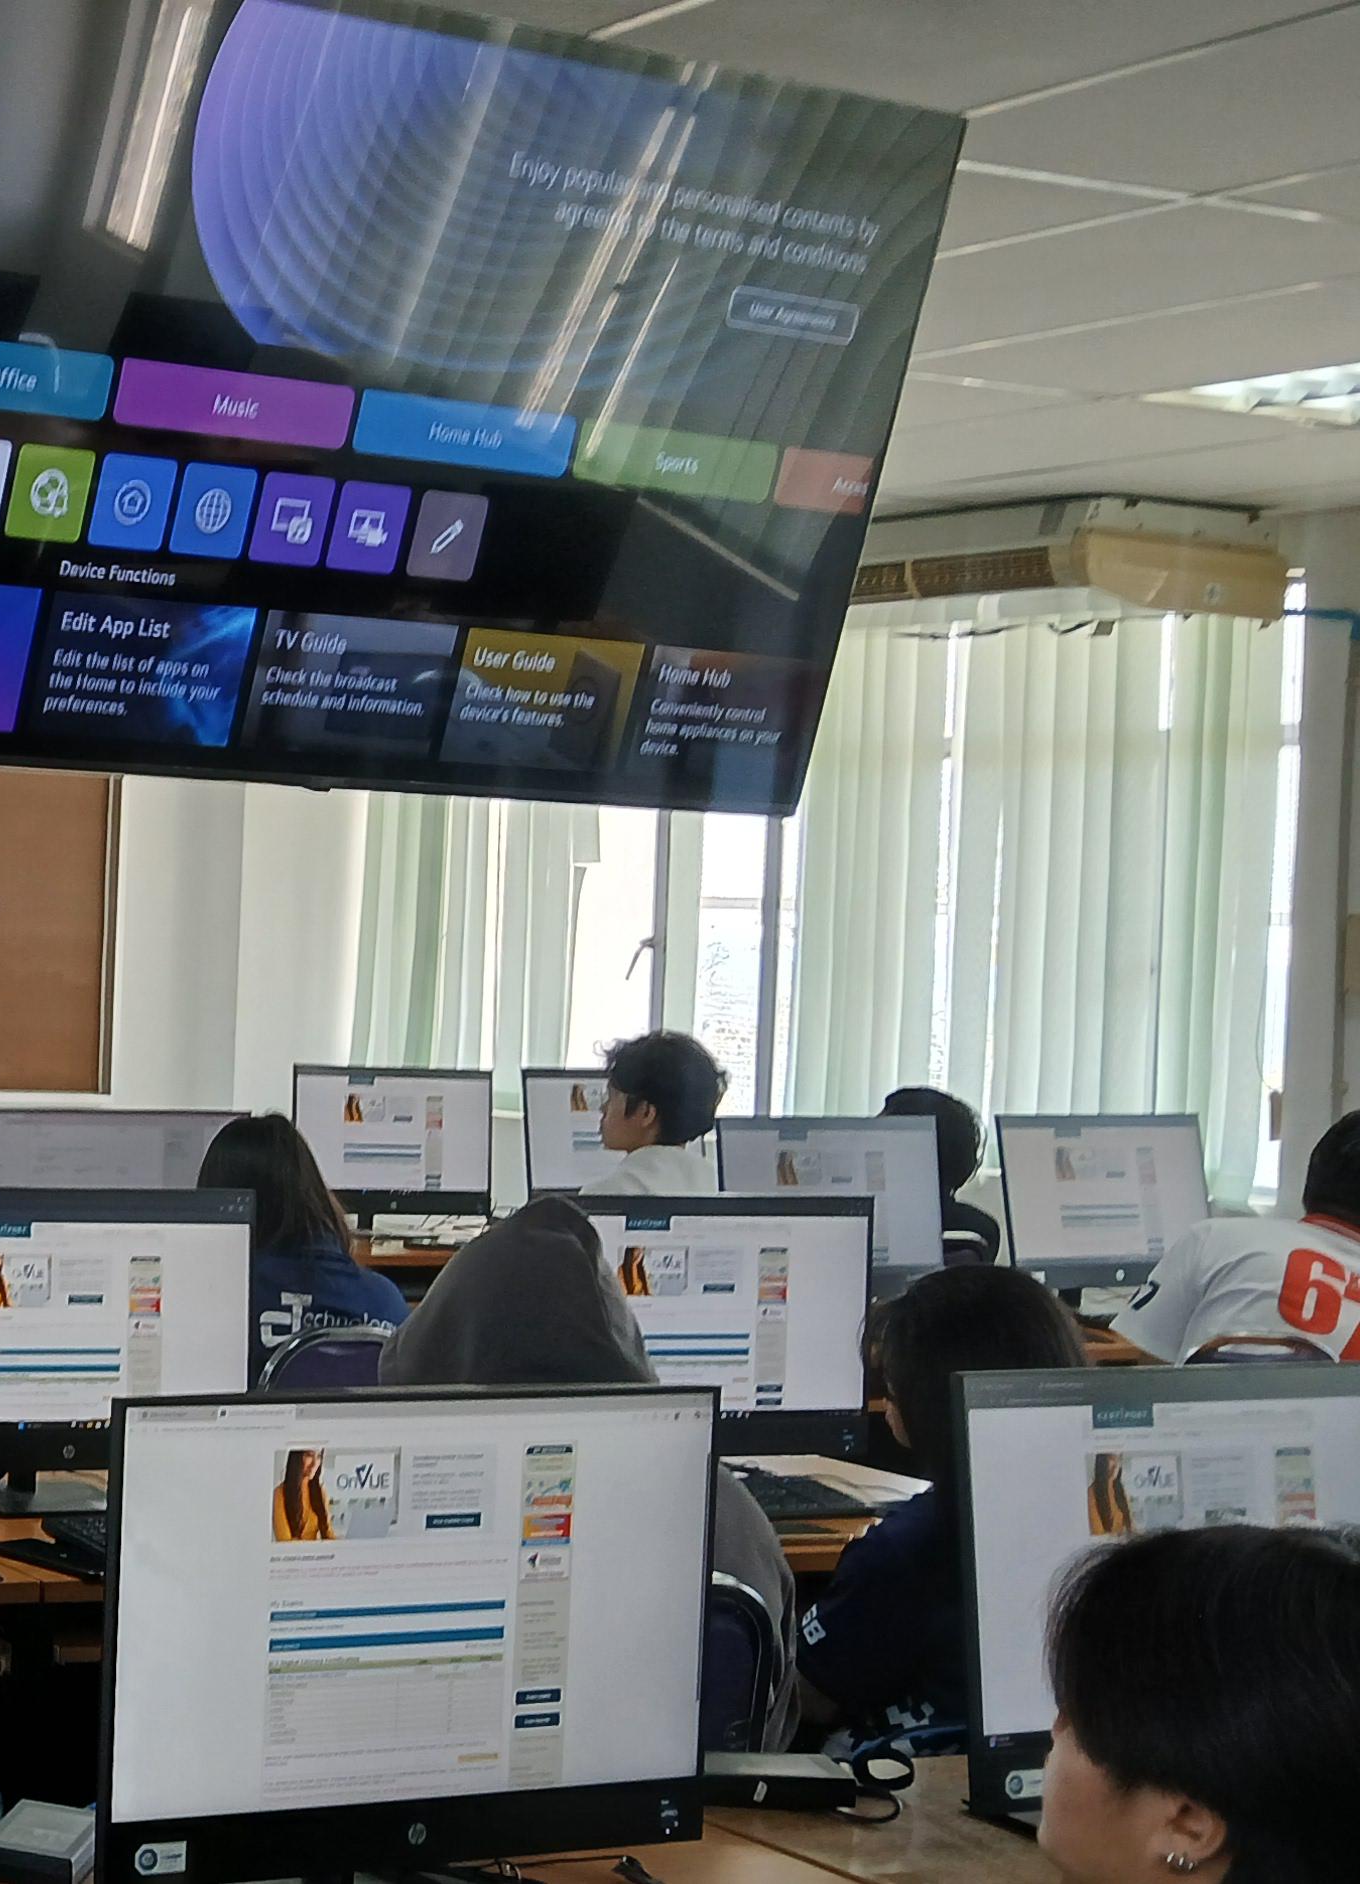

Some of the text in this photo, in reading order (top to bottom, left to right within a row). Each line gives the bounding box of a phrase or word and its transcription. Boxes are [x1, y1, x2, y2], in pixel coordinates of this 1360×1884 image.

[509, 150, 561, 191] Enjoy
[564, 166, 629, 197] popular
[672, 186, 780, 226] personalised
[782, 205, 855, 237] contents
[858, 214, 880, 246] by
[555, 201, 631, 237] agreeing
[661, 213, 691, 244] the
[694, 223, 744, 253] terms
[747, 233, 780, 259] and
[783, 234, 870, 274] conditions
[212, 393, 259, 419] Music
[429, 422, 502, 450] Home Hub
[656, 451, 699, 477] Sports
[60, 559, 176, 588] Device Functions
[60, 610, 171, 640] Edit App List
[275, 628, 348, 656] TV Guide
[52, 647, 210, 679] Edit the list of apps on
[473, 646, 556, 673] User Guide
[48, 671, 222, 704] the Home to include your
[265, 665, 398, 694] Check the broadcast
[658, 664, 732, 689] Home Hub
[43, 694, 128, 717] preferences.
[260, 688, 424, 718] schedule and information.
[465, 682, 595, 710] Check how to use the
[459, 705, 566, 729] device's features.
[649, 699, 768, 724] Conveniently control
[644, 719, 782, 746] home appliances on your
[640, 739, 680, 757] device.
[336, 1462, 390, 1491] OnVUE
